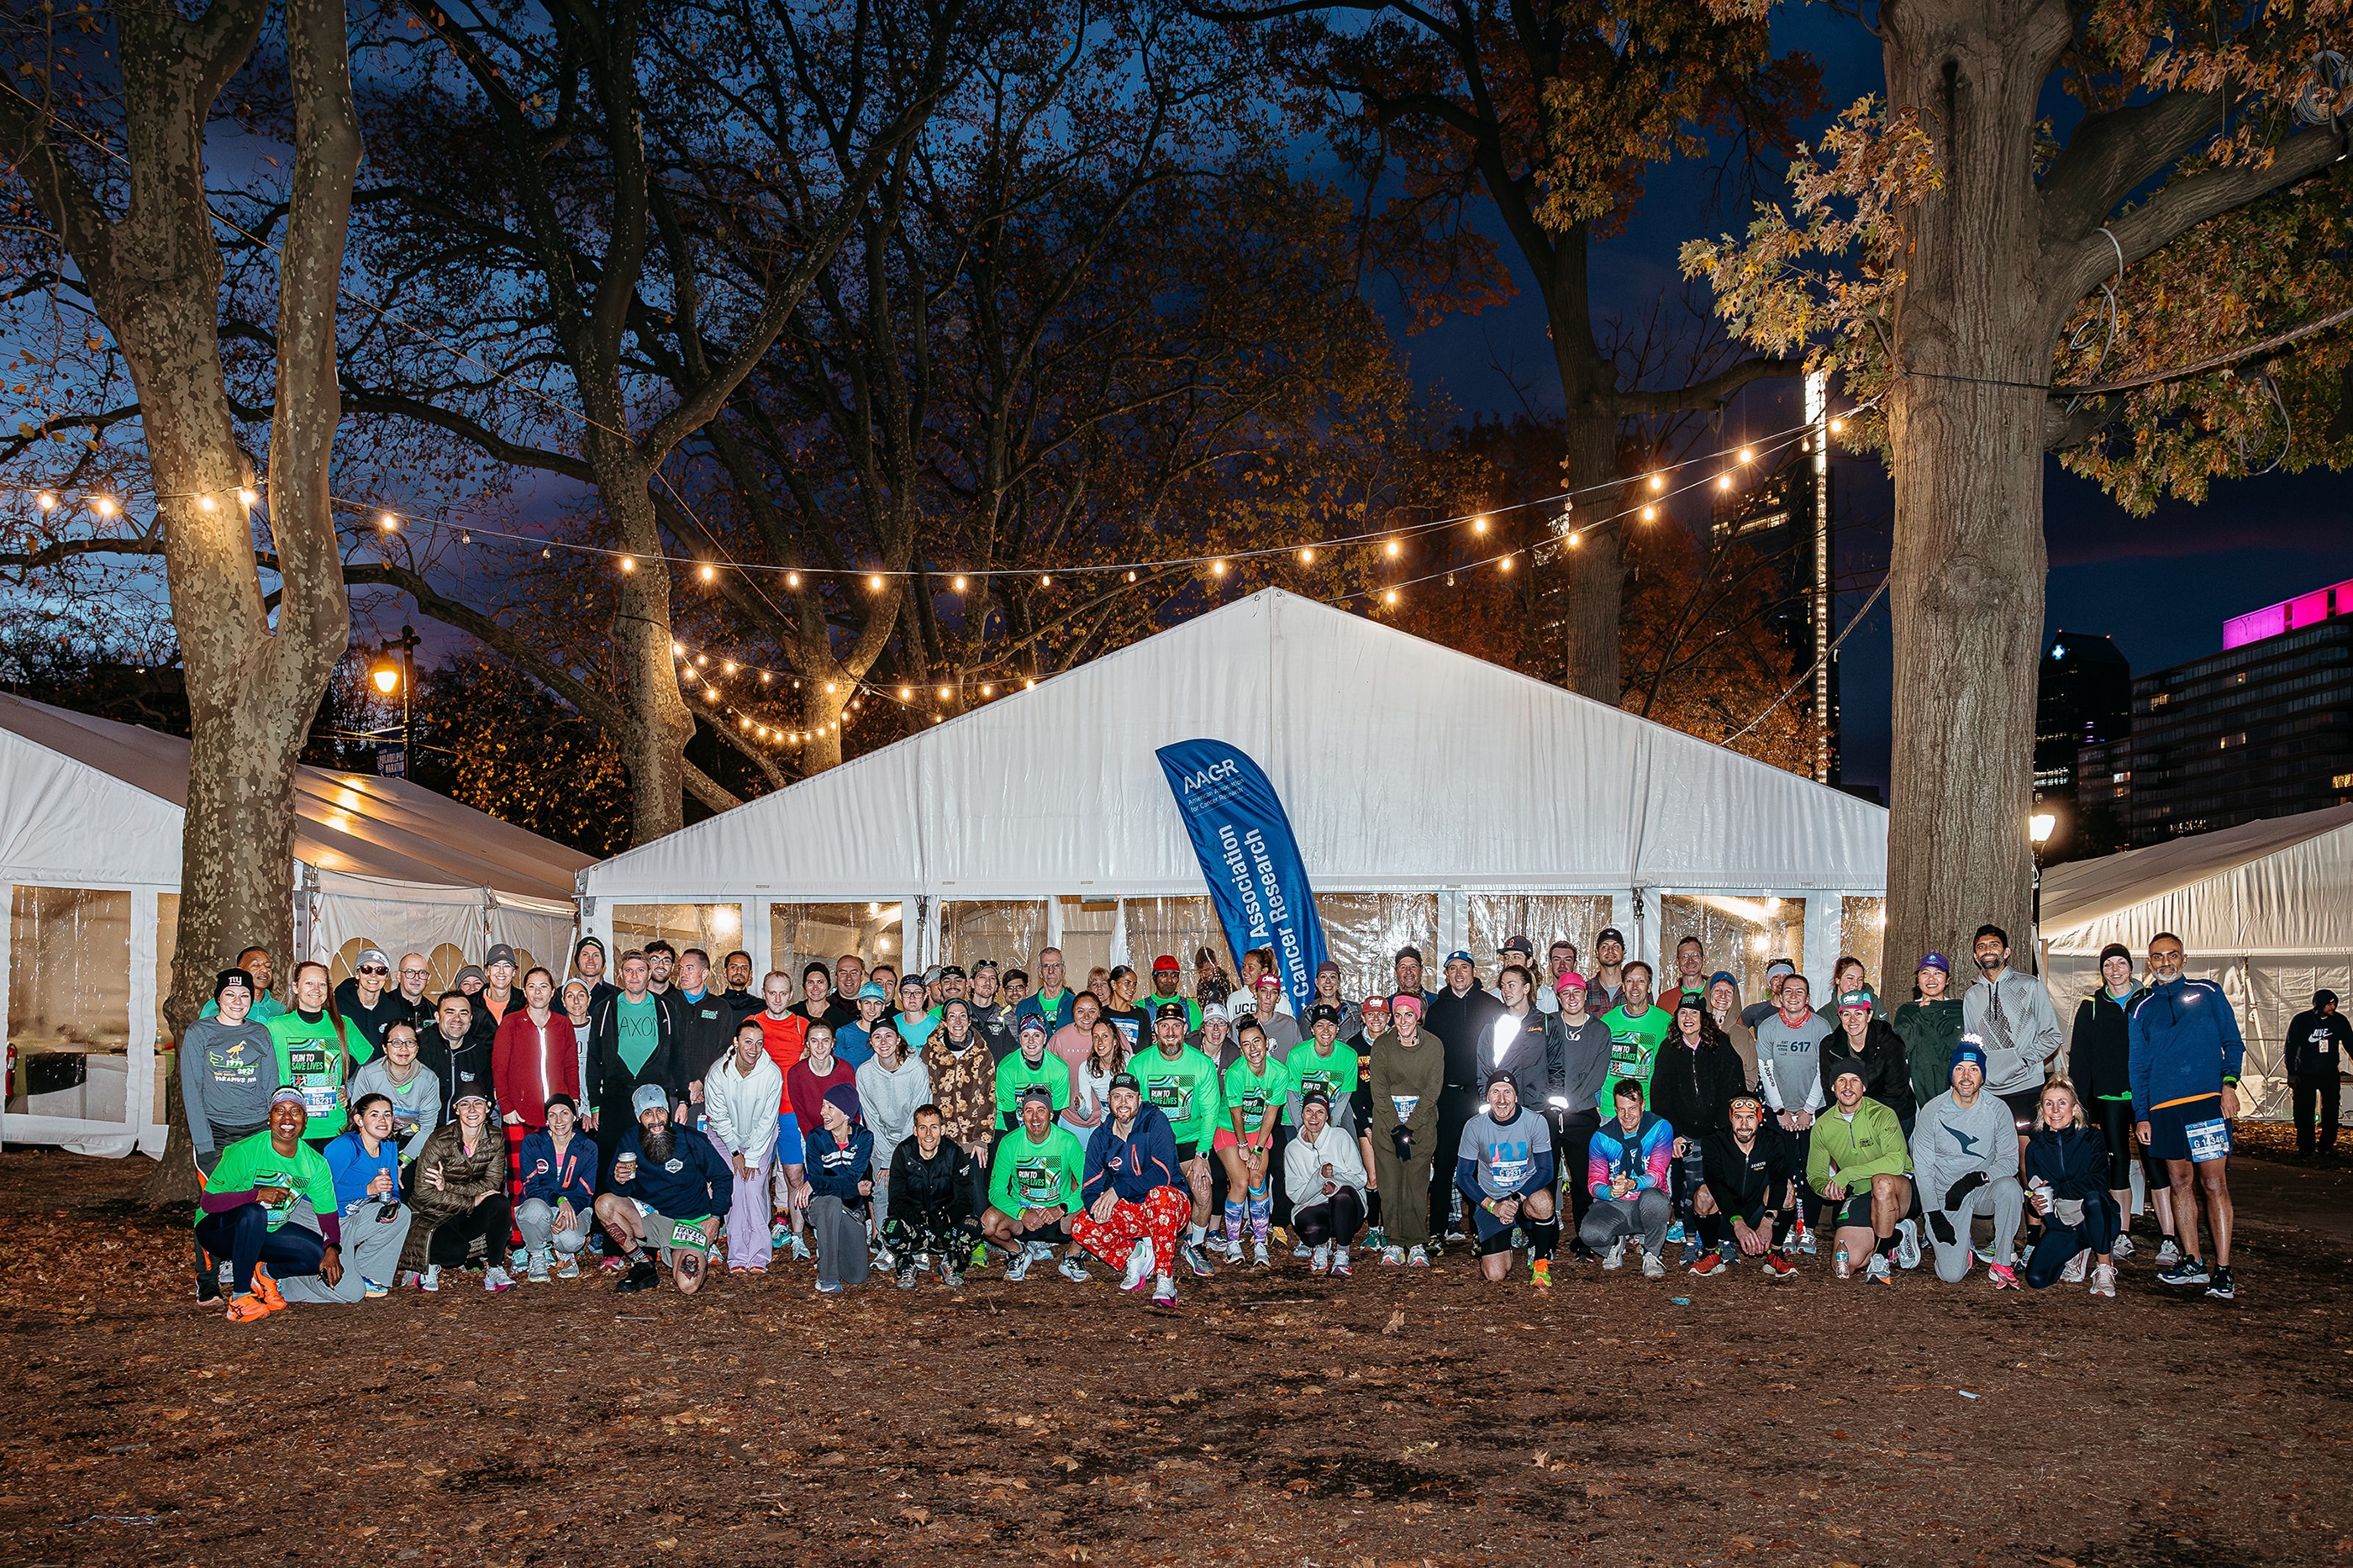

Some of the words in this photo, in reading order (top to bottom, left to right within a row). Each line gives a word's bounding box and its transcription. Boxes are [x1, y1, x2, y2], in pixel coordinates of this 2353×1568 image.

[1183, 759, 1240, 795] AACR
[1188, 791, 1213, 805] American
[1214, 778, 1245, 795] Association
[1199, 797, 1219, 809] Cancer
[1219, 824, 1270, 938] Association
[1244, 828, 1288, 924] Research
[1277, 927, 1309, 997] Cancer
[2313, 1028, 2329, 1037] NIKE
[1612, 1044, 1623, 1053] RUN
[1790, 1041, 1811, 1052] 617
[292, 1053, 306, 1062] RUN
[306, 1053, 315, 1062] TO
[291, 1062, 307, 1071] SAVE
[307, 1062, 324, 1071] LIVES
[312, 1096, 333, 1105] 16231
[1164, 1097, 1177, 1105] LIVES
[2193, 1139, 2200, 1148] G
[2202, 1135, 2224, 1146] 14346
[1505, 1168, 1522, 1177] 9931
[674, 1233, 704, 1244] APRIL
[676, 1228, 704, 1239] DAVID
[1905, 1234, 1915, 1259] BROOKS
